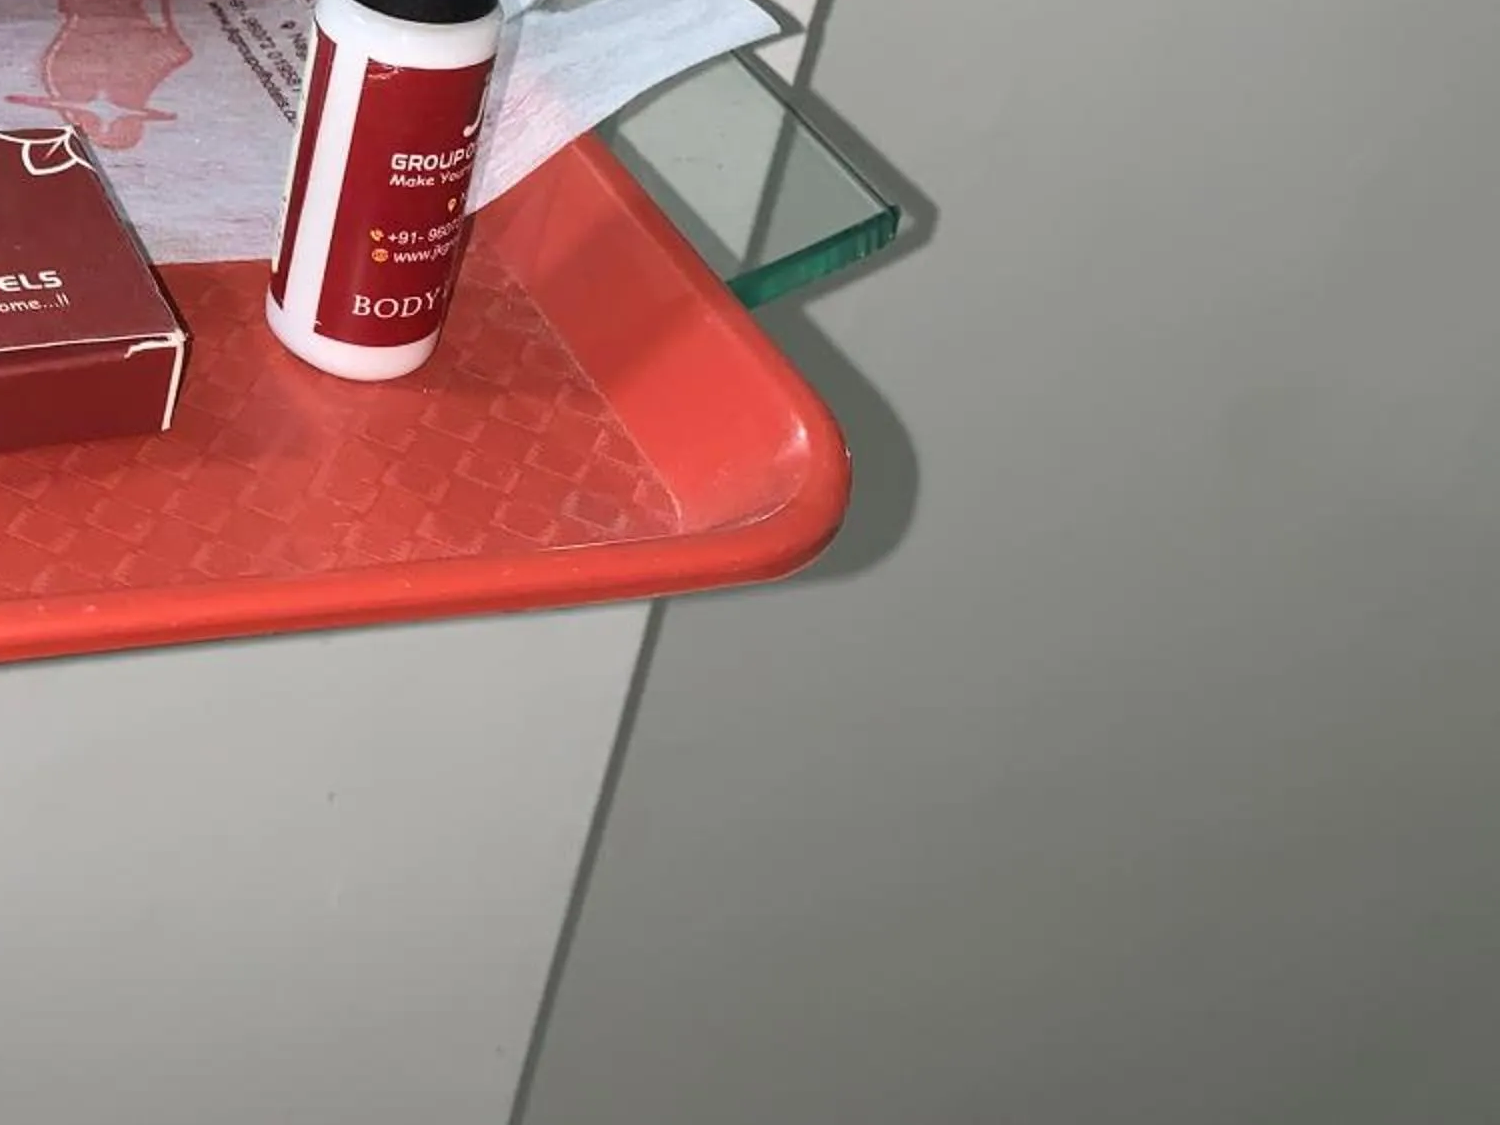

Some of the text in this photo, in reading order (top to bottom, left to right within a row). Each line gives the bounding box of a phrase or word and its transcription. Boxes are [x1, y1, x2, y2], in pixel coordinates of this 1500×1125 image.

[390, 147, 466, 172] GROUP
[389, 173, 436, 188] Make
[387, 230, 426, 245] +91-
[351, 286, 441, 319] BODY
